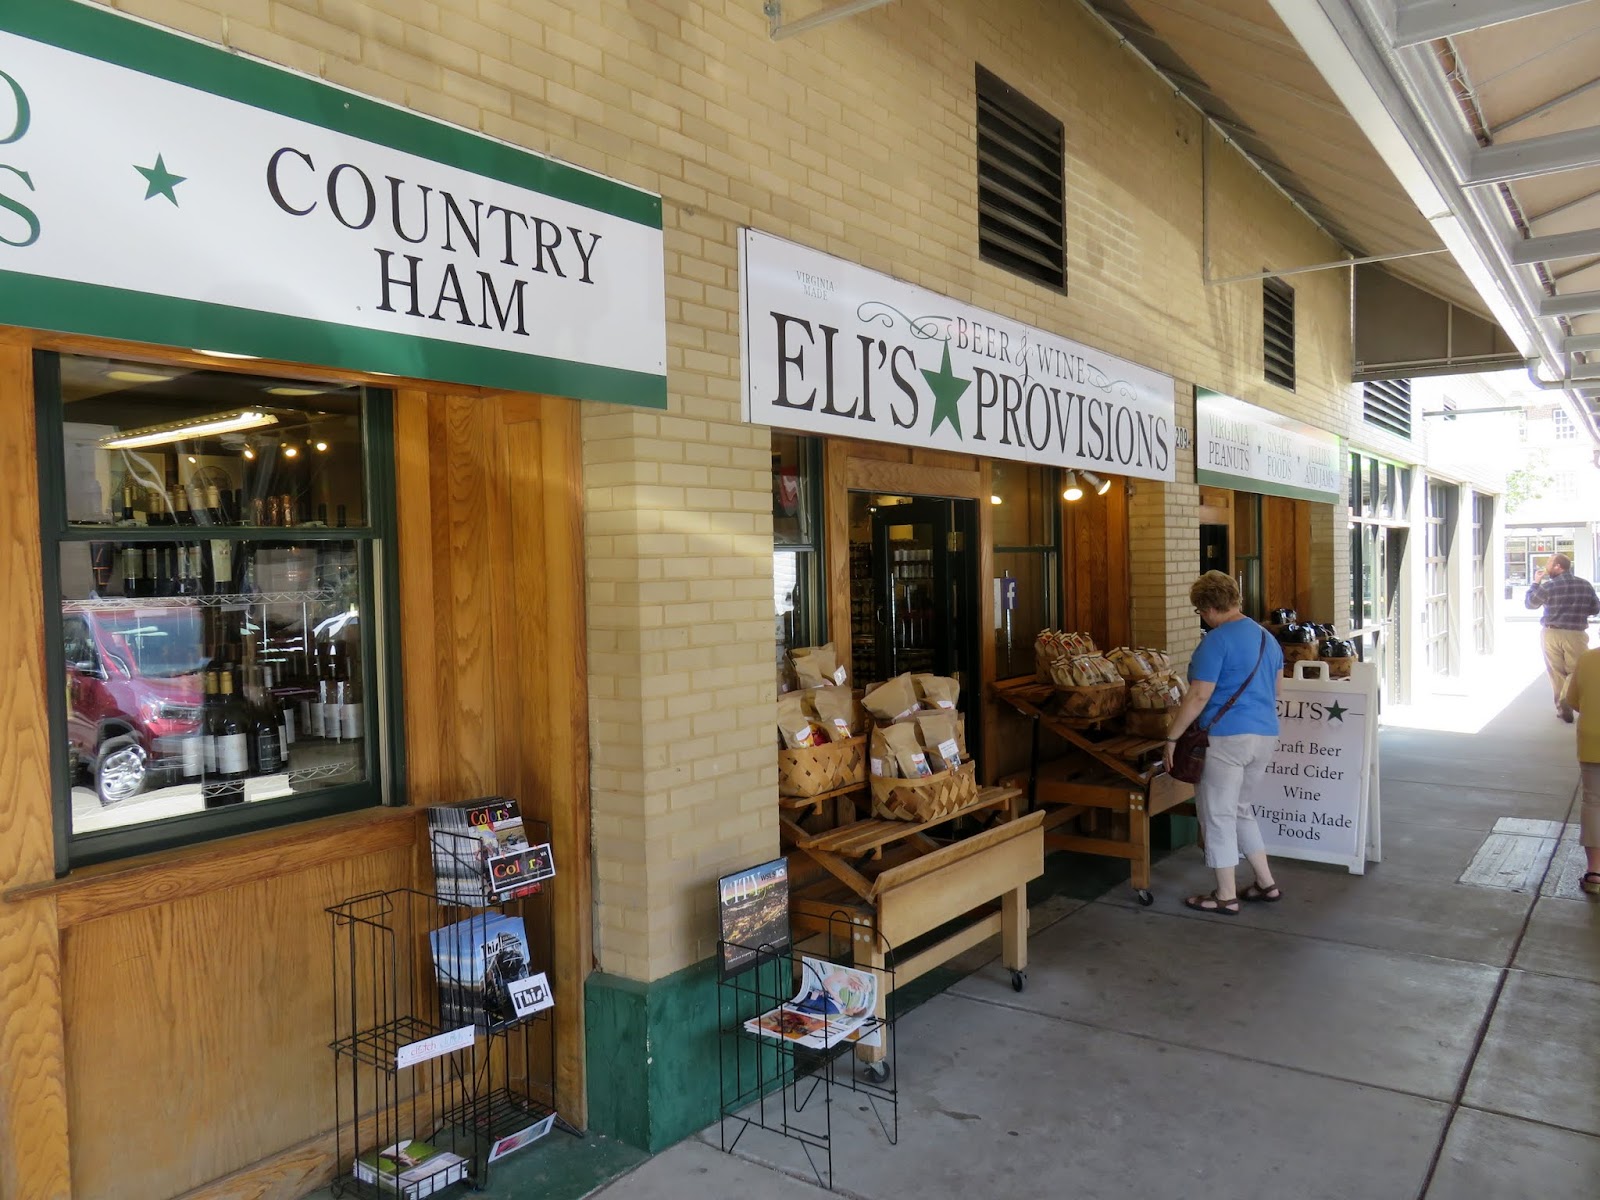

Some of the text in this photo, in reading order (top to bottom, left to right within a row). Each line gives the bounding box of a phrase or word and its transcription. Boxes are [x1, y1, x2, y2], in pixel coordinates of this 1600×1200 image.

[266, 147, 602, 284] COUNTRY
[374, 248, 530, 336] HAM
[796, 270, 834, 292] VIRGINIA
[803, 284, 828, 301] MADE
[956, 316, 1011, 364] BEER
[1036, 343, 1085, 385] WINE
[770, 311, 1168, 472] ELI'S PROVISIONS
[1208, 414, 1250, 447] VIRGINIA
[1208, 440, 1250, 472] PEANUTS
[1267, 455, 1292, 480] FOODS
[1309, 742, 1342, 757] Beer
[1304, 765, 1344, 780] Cider
[1283, 785, 1321, 801] Wine
[470, 807, 509, 826] Colors
[1251, 804, 1353, 829] Virginia Made
[1278, 823, 1321, 841] Foods
[514, 983, 549, 1010] This!
